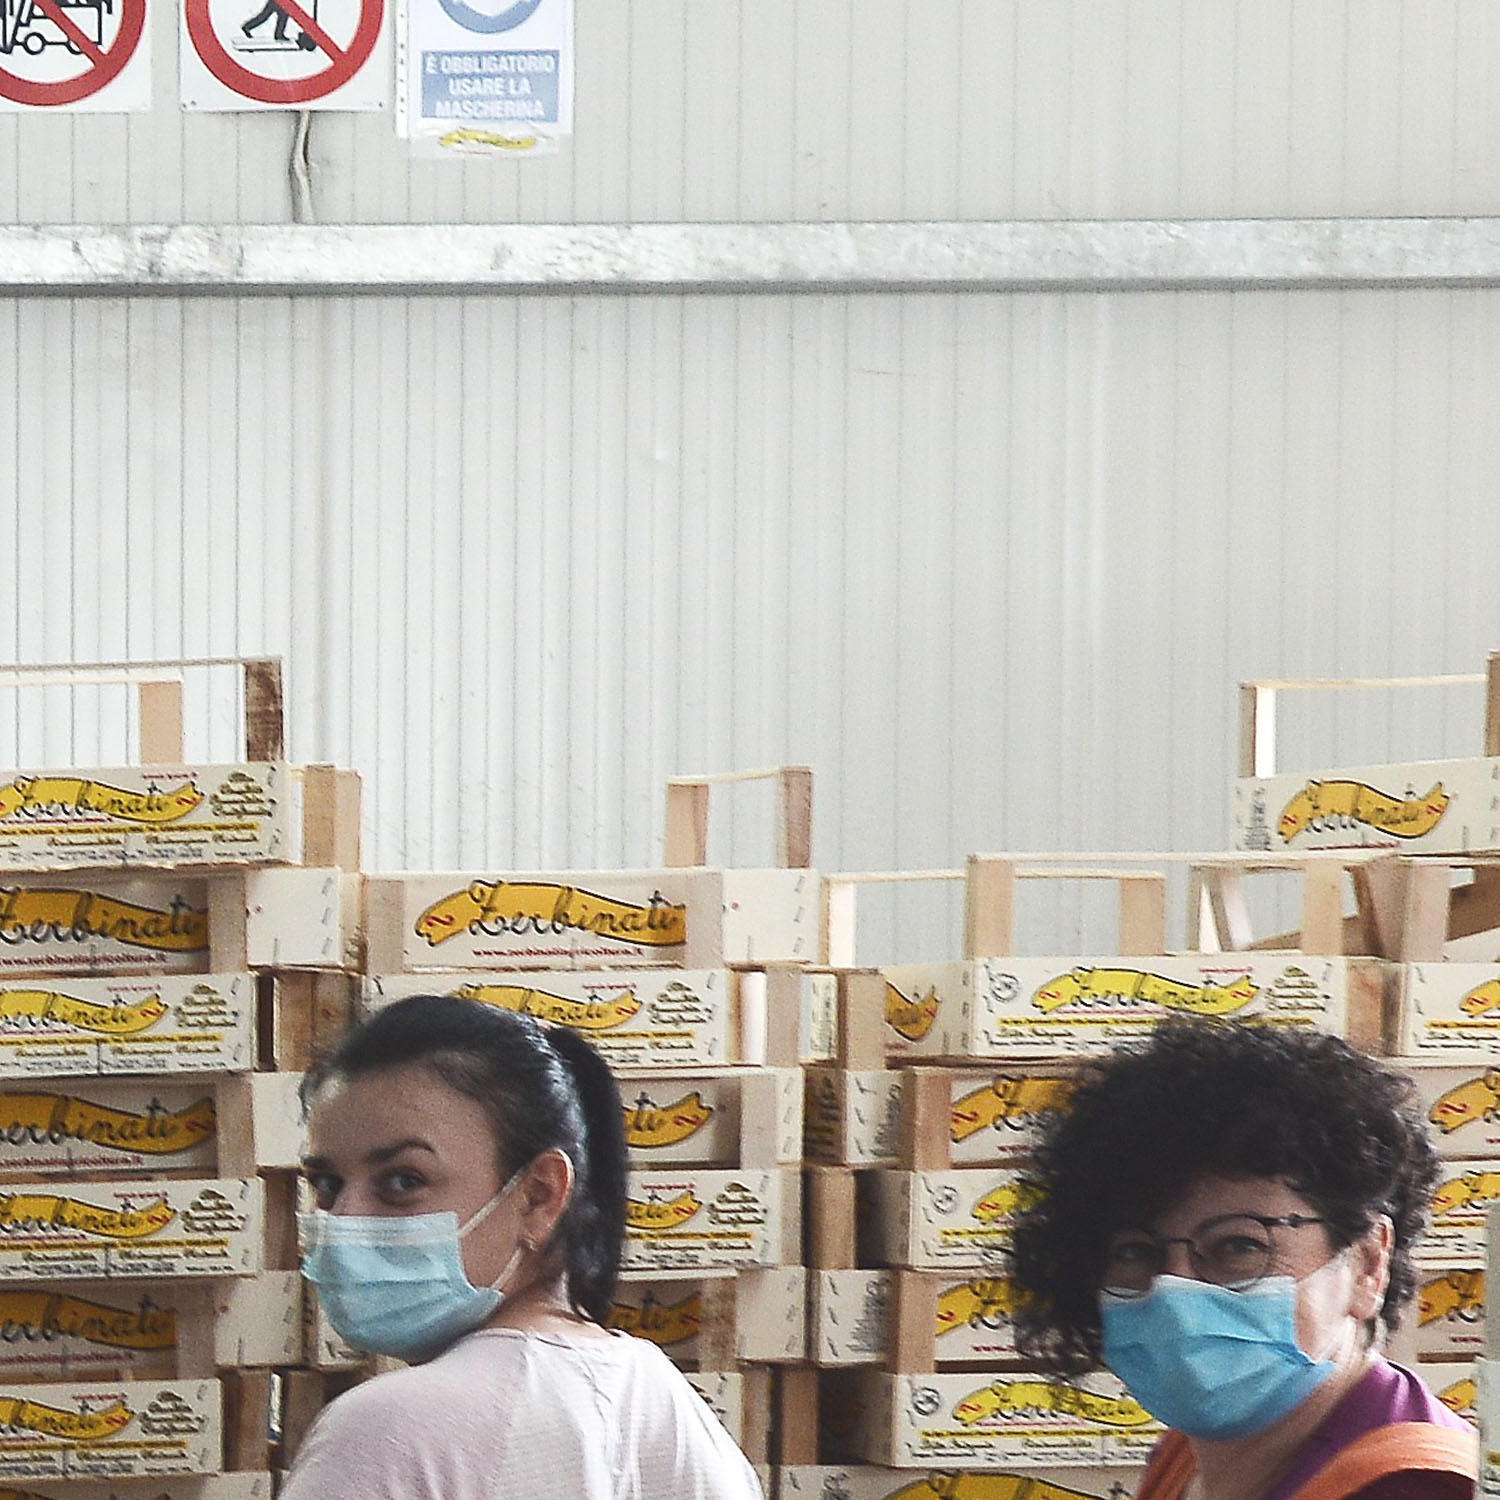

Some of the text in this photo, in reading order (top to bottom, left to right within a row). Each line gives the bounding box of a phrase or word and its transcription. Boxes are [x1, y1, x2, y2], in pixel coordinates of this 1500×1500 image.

[425, 52, 555, 74] È OBBLIGATORIO
[448, 77, 532, 96] USARE LA
[434, 99, 545, 118] MASCHERINA
[14, 775, 169, 818] Zerbinati
[468, 880, 679, 937] Zerbinati
